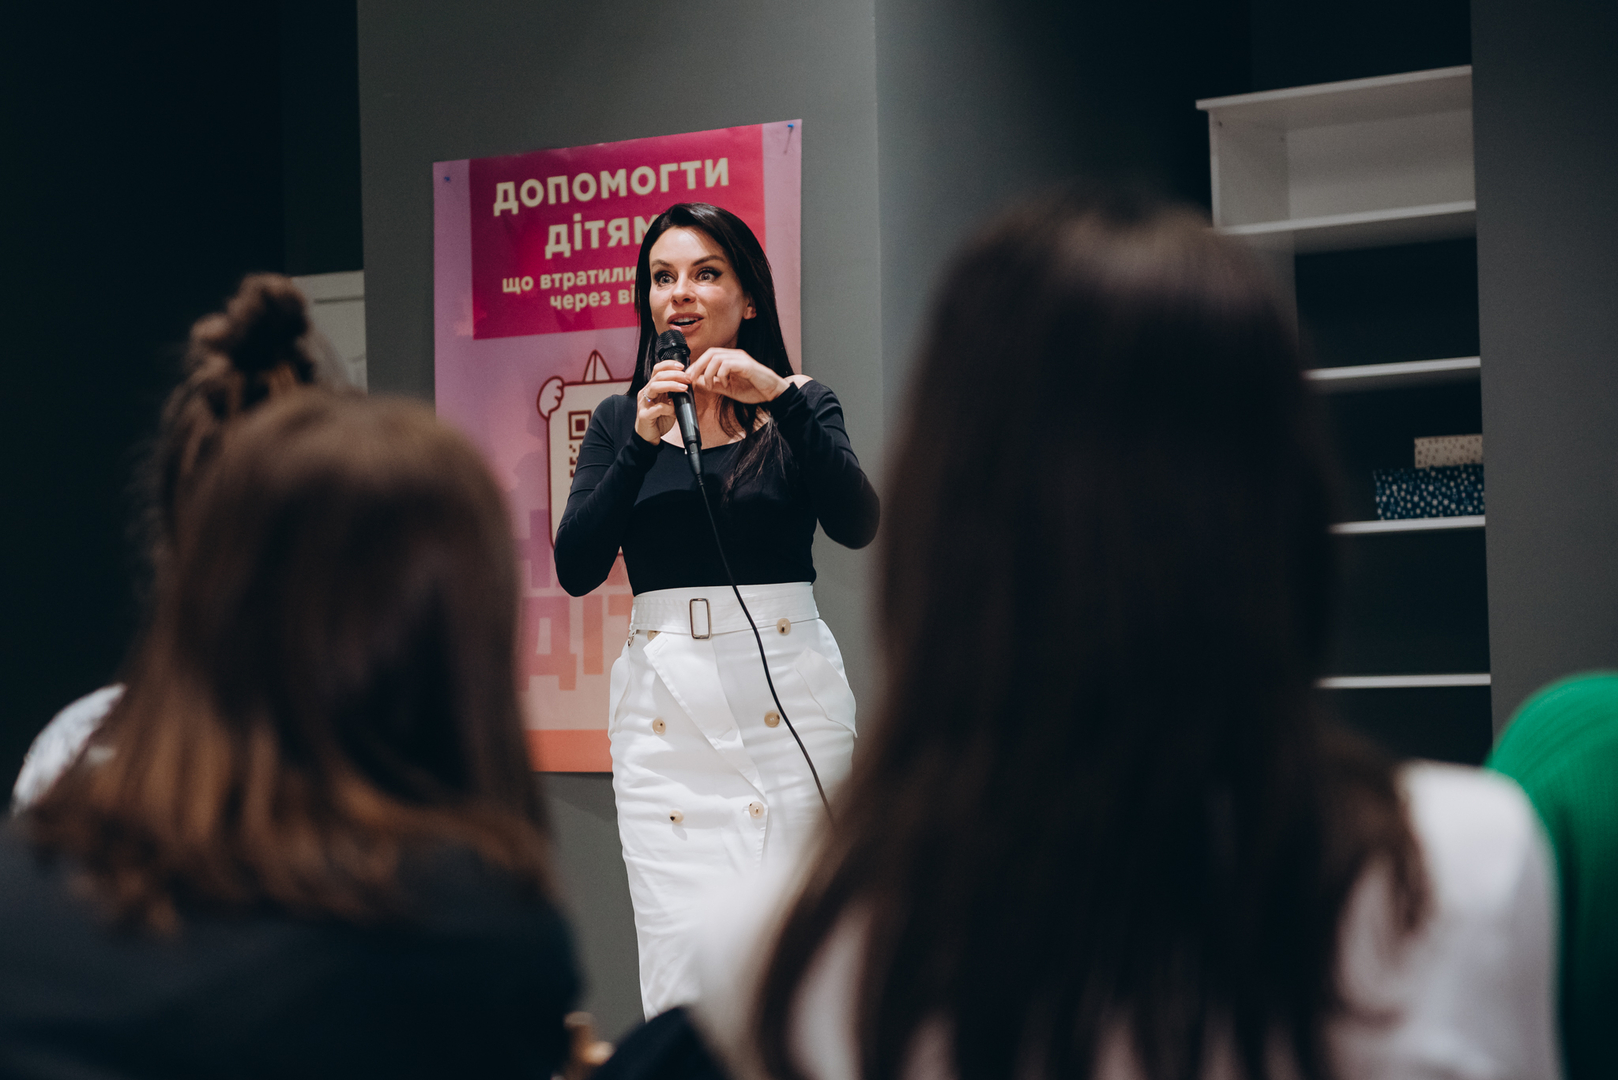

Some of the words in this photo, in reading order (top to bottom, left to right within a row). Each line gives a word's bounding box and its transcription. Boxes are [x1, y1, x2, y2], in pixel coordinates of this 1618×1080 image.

[502, 275, 534, 295] що
[540, 266, 637, 291] втратили
[550, 290, 611, 312] через
